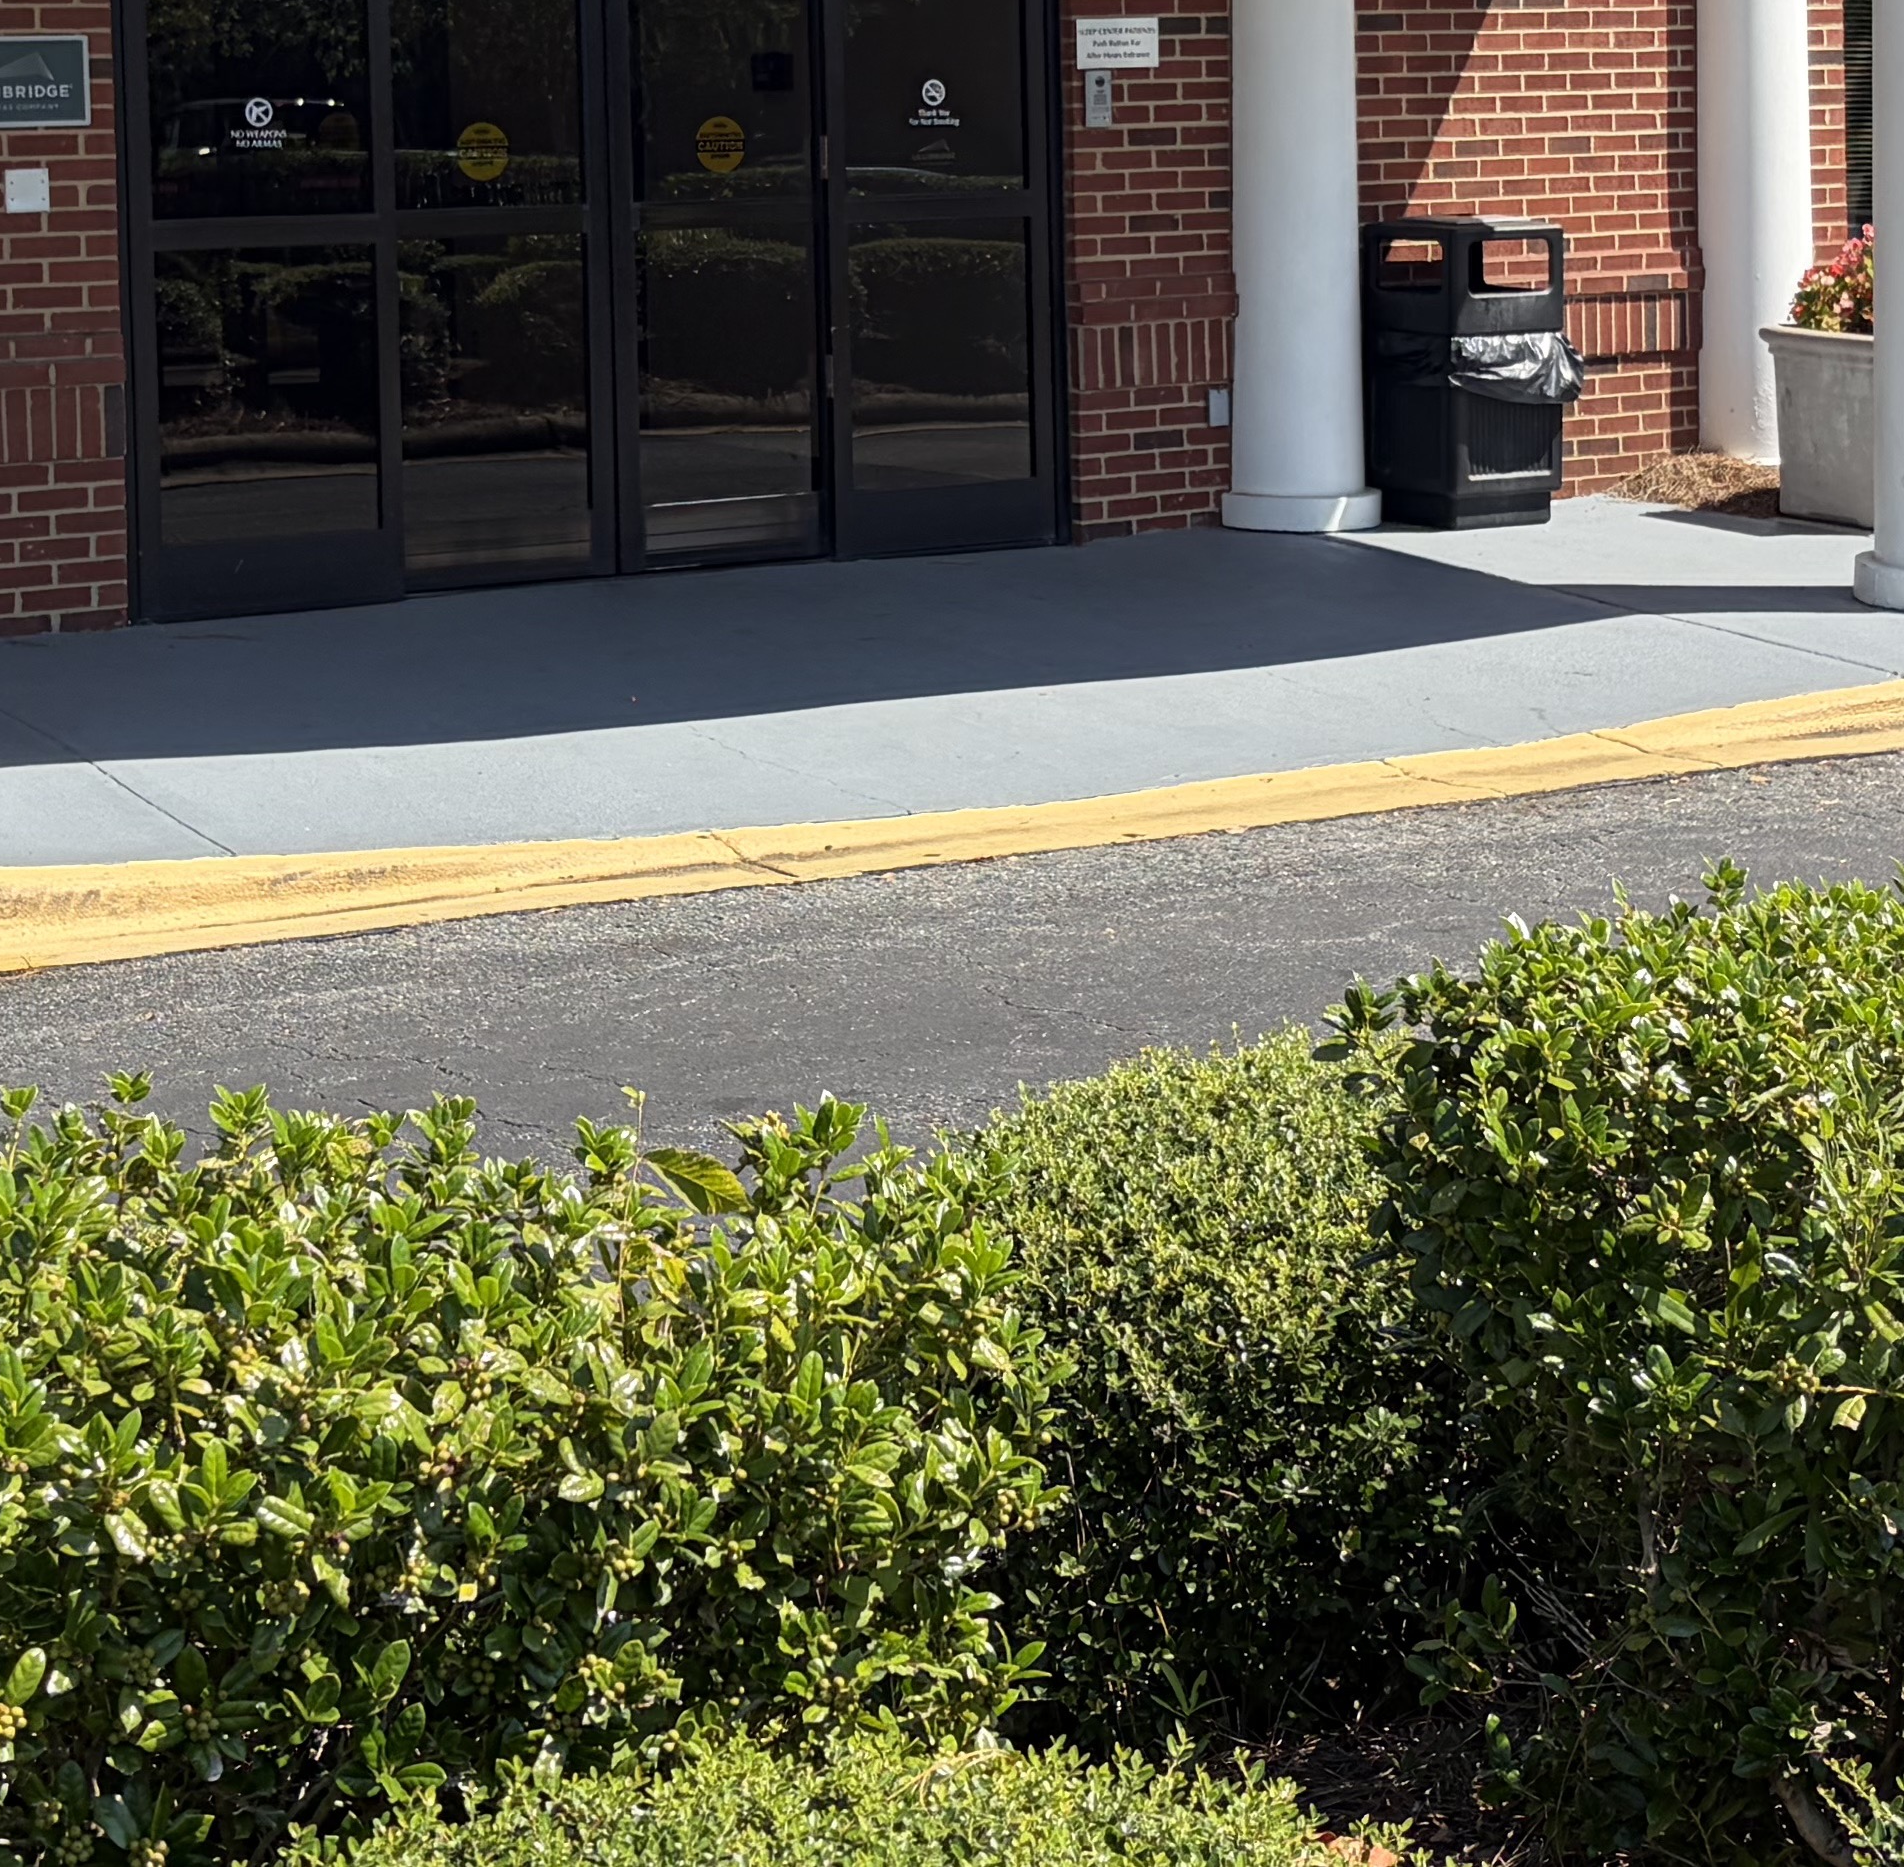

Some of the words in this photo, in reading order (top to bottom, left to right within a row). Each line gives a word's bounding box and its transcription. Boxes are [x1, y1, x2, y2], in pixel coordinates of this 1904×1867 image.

[16, 103, 59, 111] COMPANY
[230, 129, 245, 139] NO
[245, 129, 288, 139] WEAPONS
[235, 139, 250, 148] NO
[697, 141, 744, 151] CAUTION
